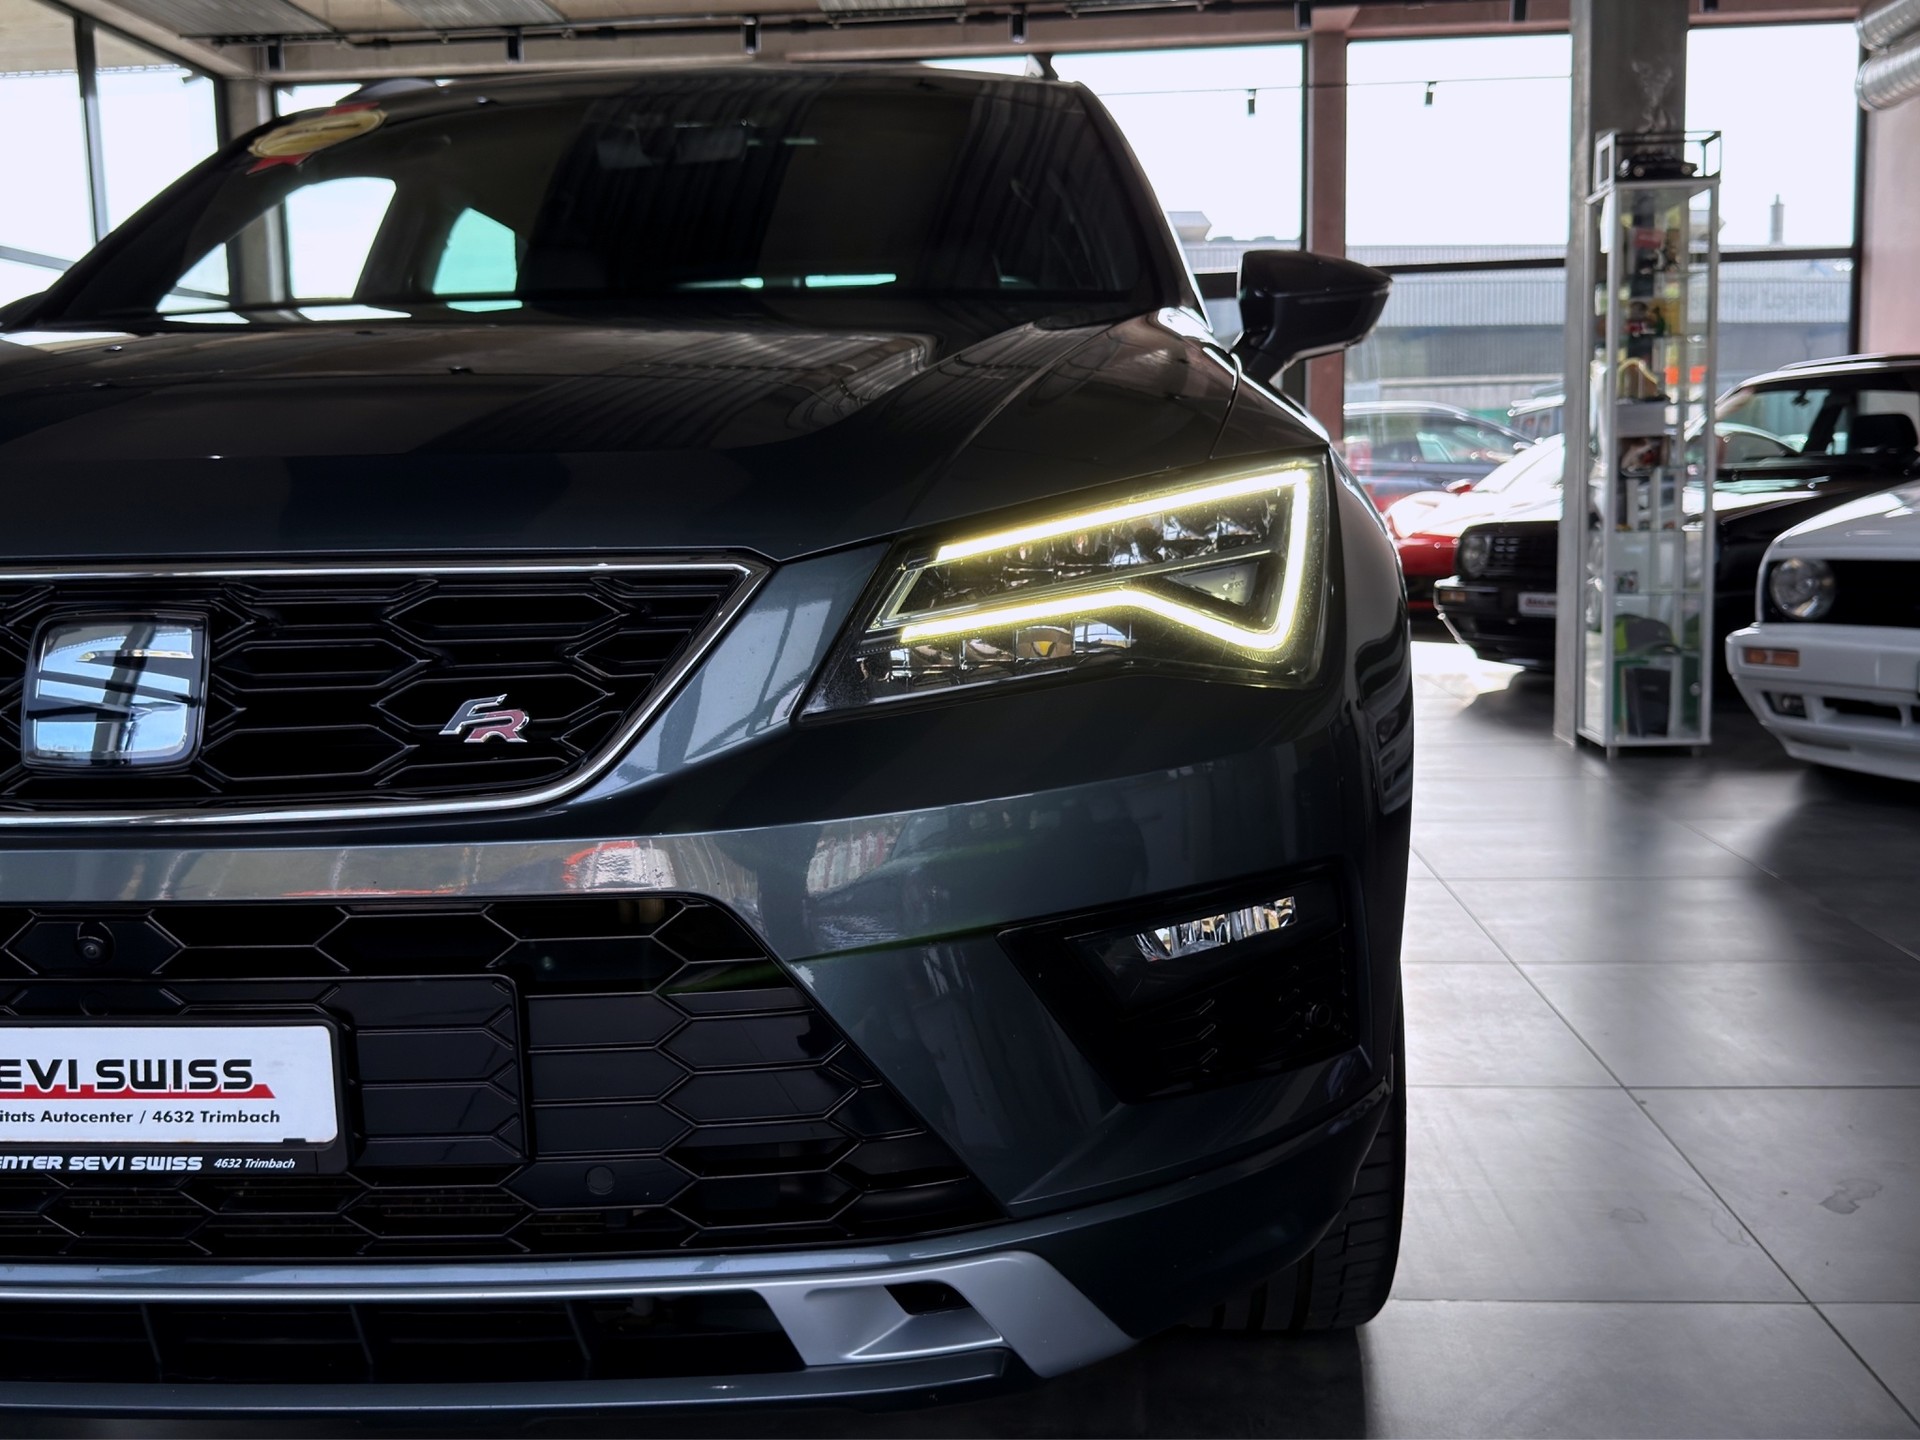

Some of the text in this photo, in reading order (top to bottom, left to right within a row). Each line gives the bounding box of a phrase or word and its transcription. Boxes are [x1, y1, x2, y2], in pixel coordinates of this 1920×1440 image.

[439, 694, 530, 743] FR
[95, 1059, 253, 1090] SWISS
[40, 1110, 134, 1124] Autocenter
[152, 1110, 195, 1124] 4632
[200, 1110, 281, 1124] Trimbach
[0, 1156, 296, 1171] NTER SEVI SWISS 4632 Trimbach
